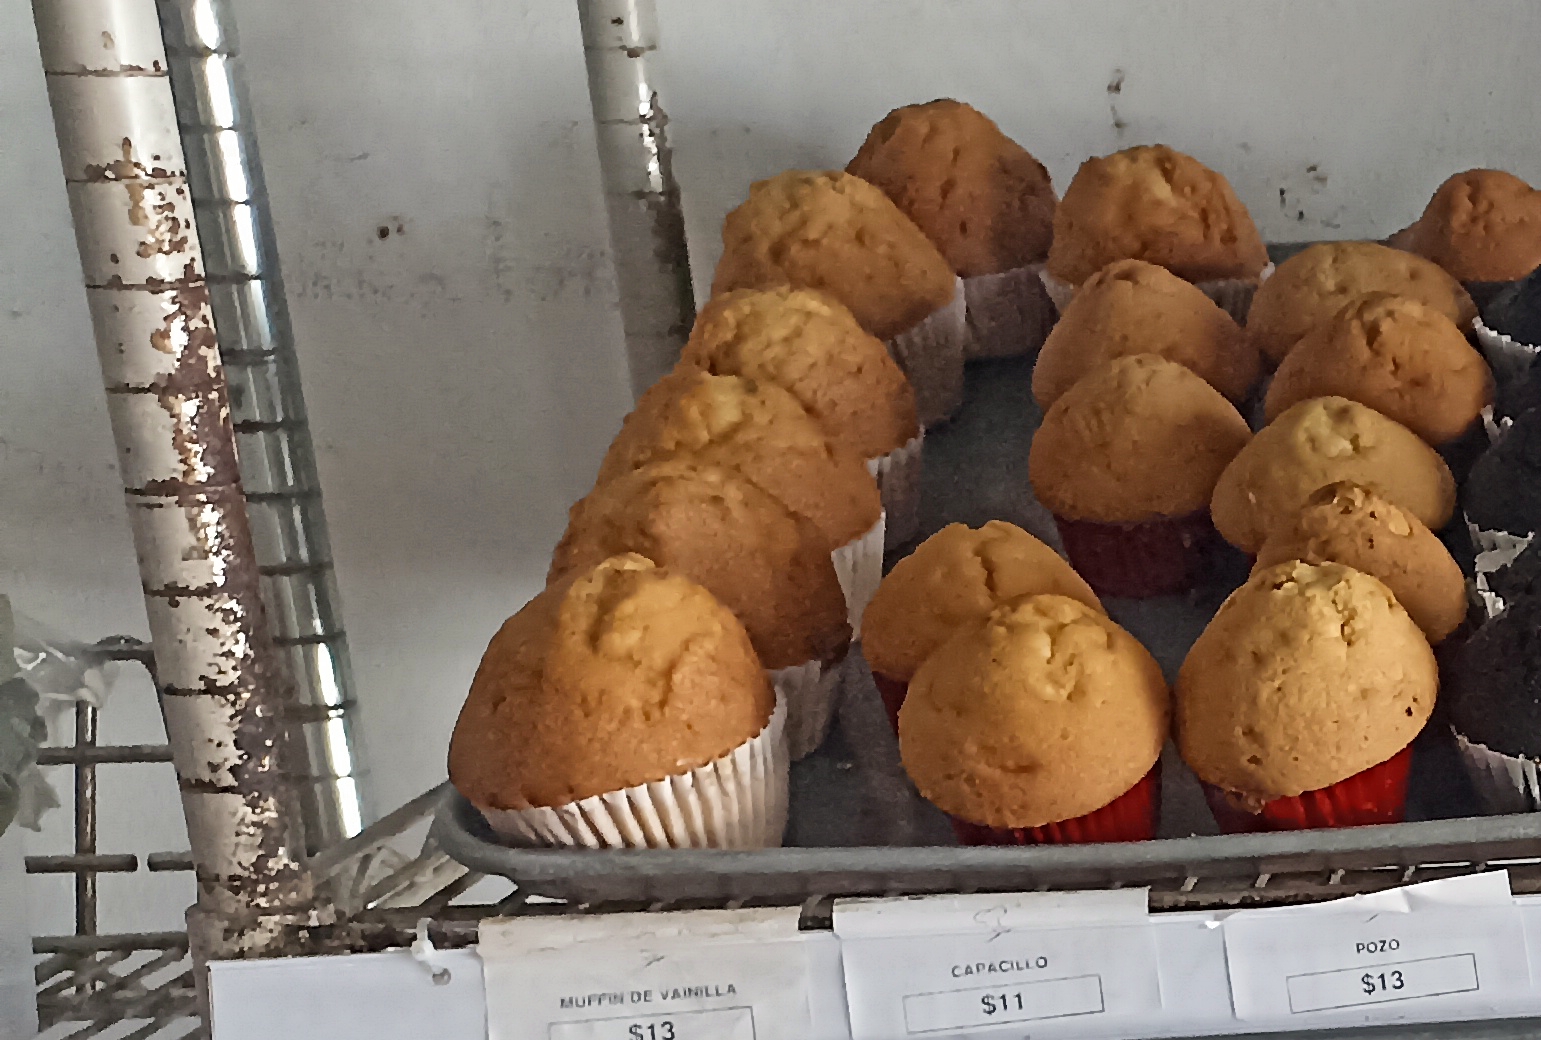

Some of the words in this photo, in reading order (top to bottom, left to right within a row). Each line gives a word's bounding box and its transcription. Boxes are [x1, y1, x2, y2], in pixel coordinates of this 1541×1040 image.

[1356, 938, 1400, 954] POZO
[951, 956, 1048, 978] CAPACILLO
[1361, 970, 1405, 995] $13
[560, 992, 624, 1009] MUFFIN
[630, 989, 653, 1004] DE
[660, 983, 737, 1001] VAINILLA
[981, 992, 1024, 1015] $11
